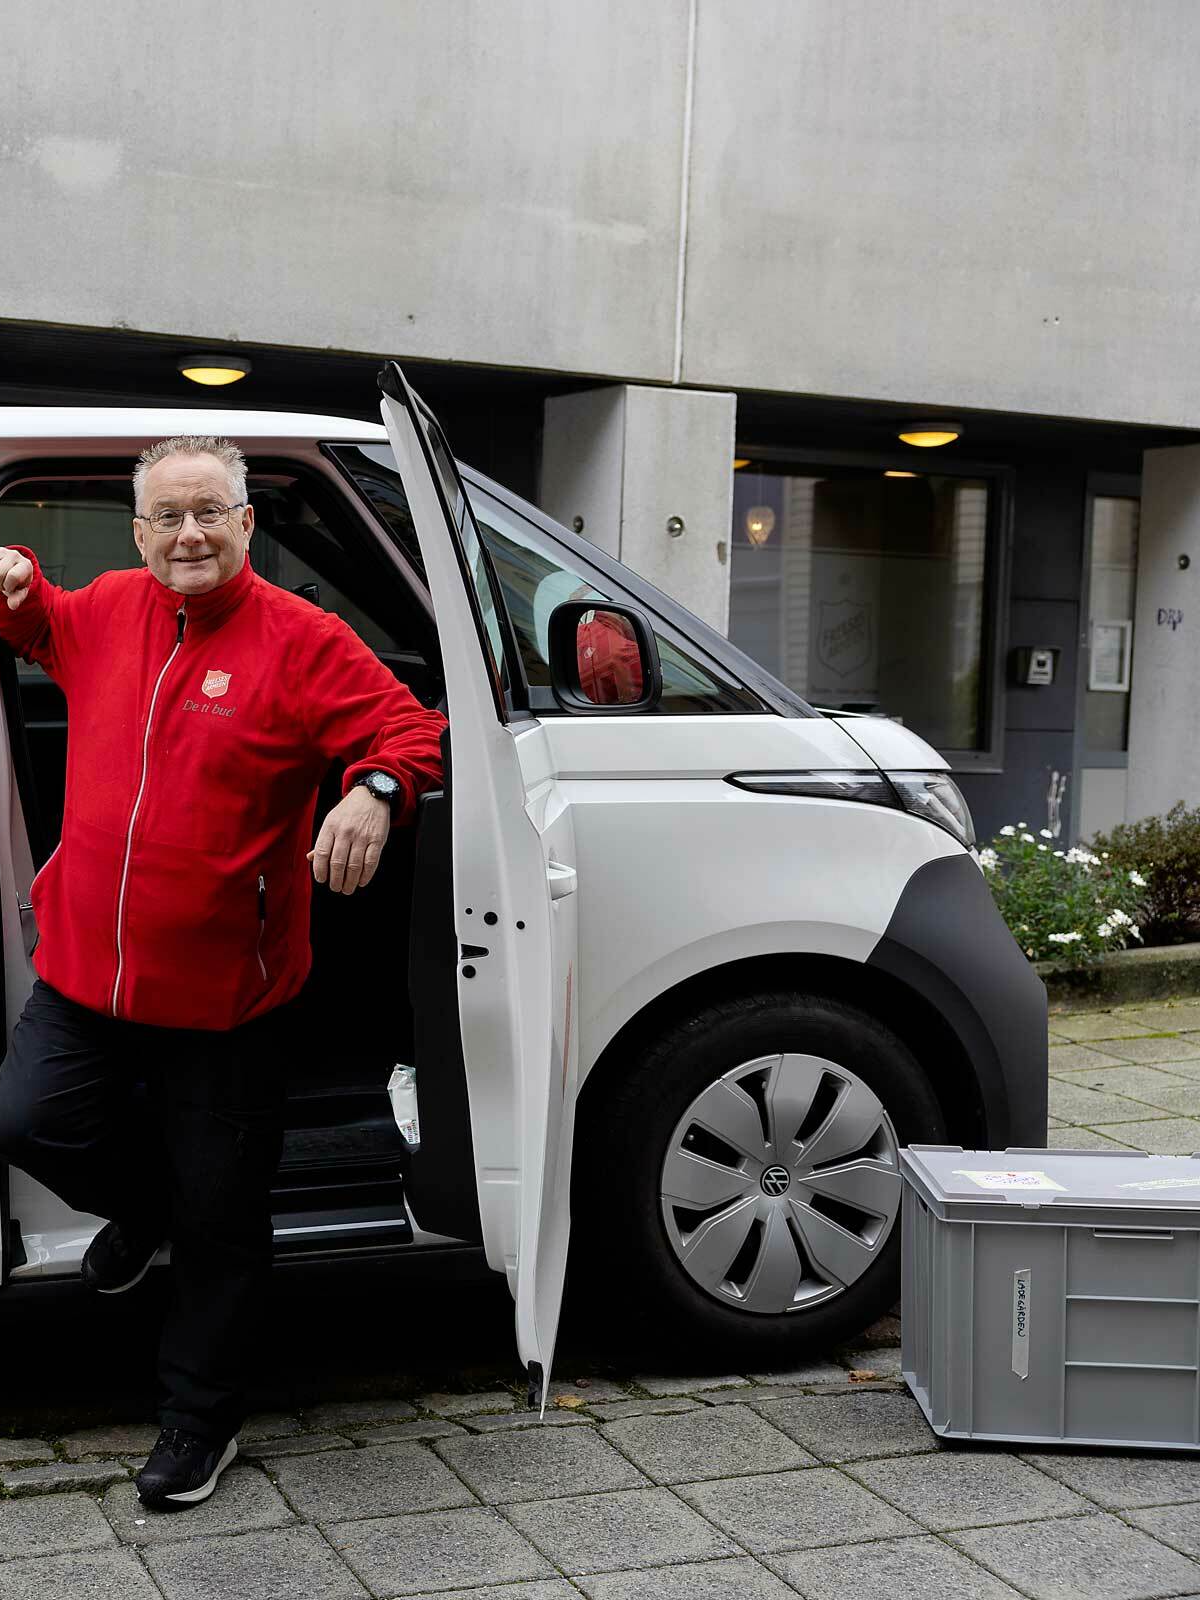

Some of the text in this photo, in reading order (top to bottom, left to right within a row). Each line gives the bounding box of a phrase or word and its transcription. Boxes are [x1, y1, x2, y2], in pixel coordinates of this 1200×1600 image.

[182, 699, 236, 718] De ti bud
